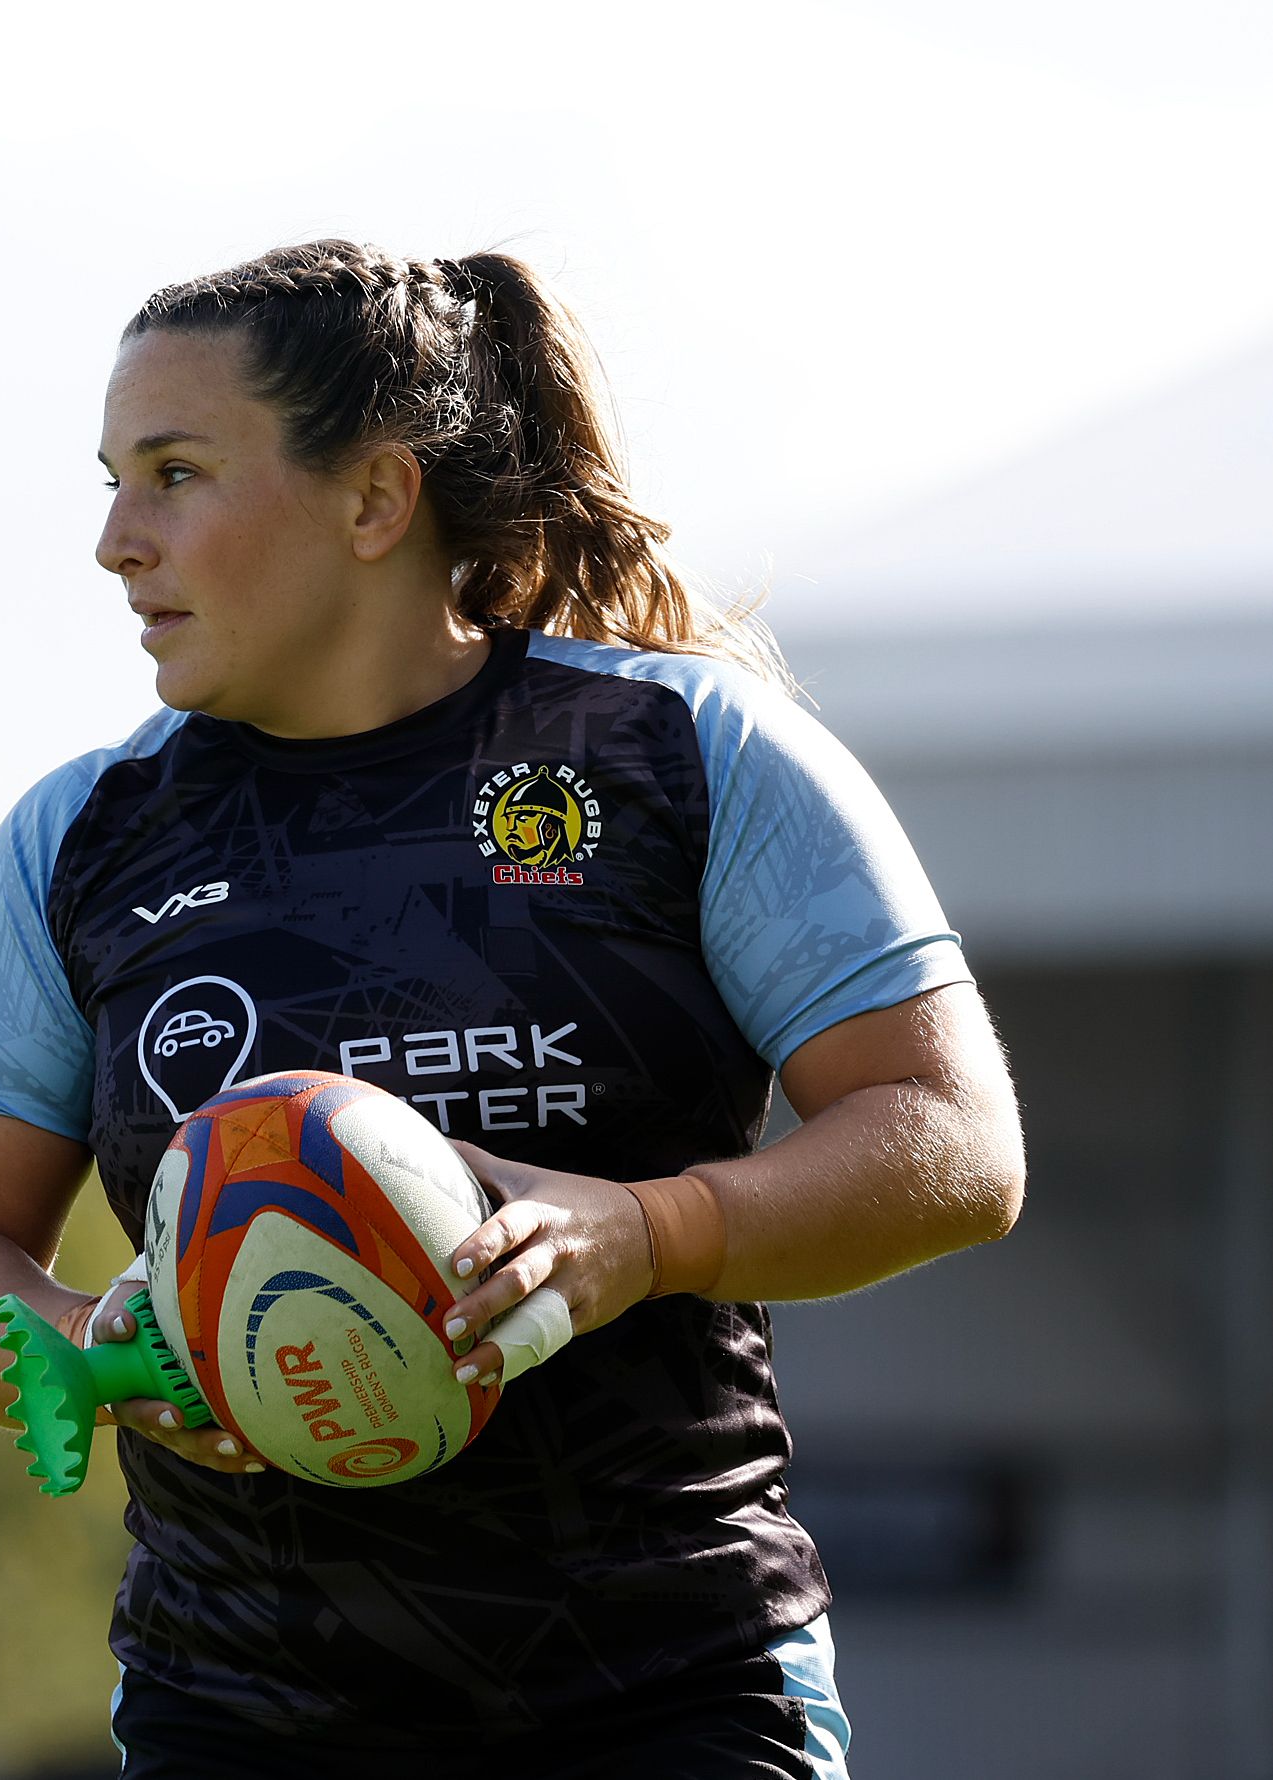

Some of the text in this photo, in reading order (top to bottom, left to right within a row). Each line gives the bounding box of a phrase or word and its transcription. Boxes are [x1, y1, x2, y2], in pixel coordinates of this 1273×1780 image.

[472, 762, 602, 858] EXETER RUGBY
[131, 881, 230, 924] VX3
[493, 865, 584, 885] Chiefs
[397, 1083, 588, 1134] TER
[275, 1340, 357, 1442] PWR
[341, 1359, 385, 1429] PREMIERSHIP
[345, 1328, 399, 1423] WOMEN'S RUGBY
